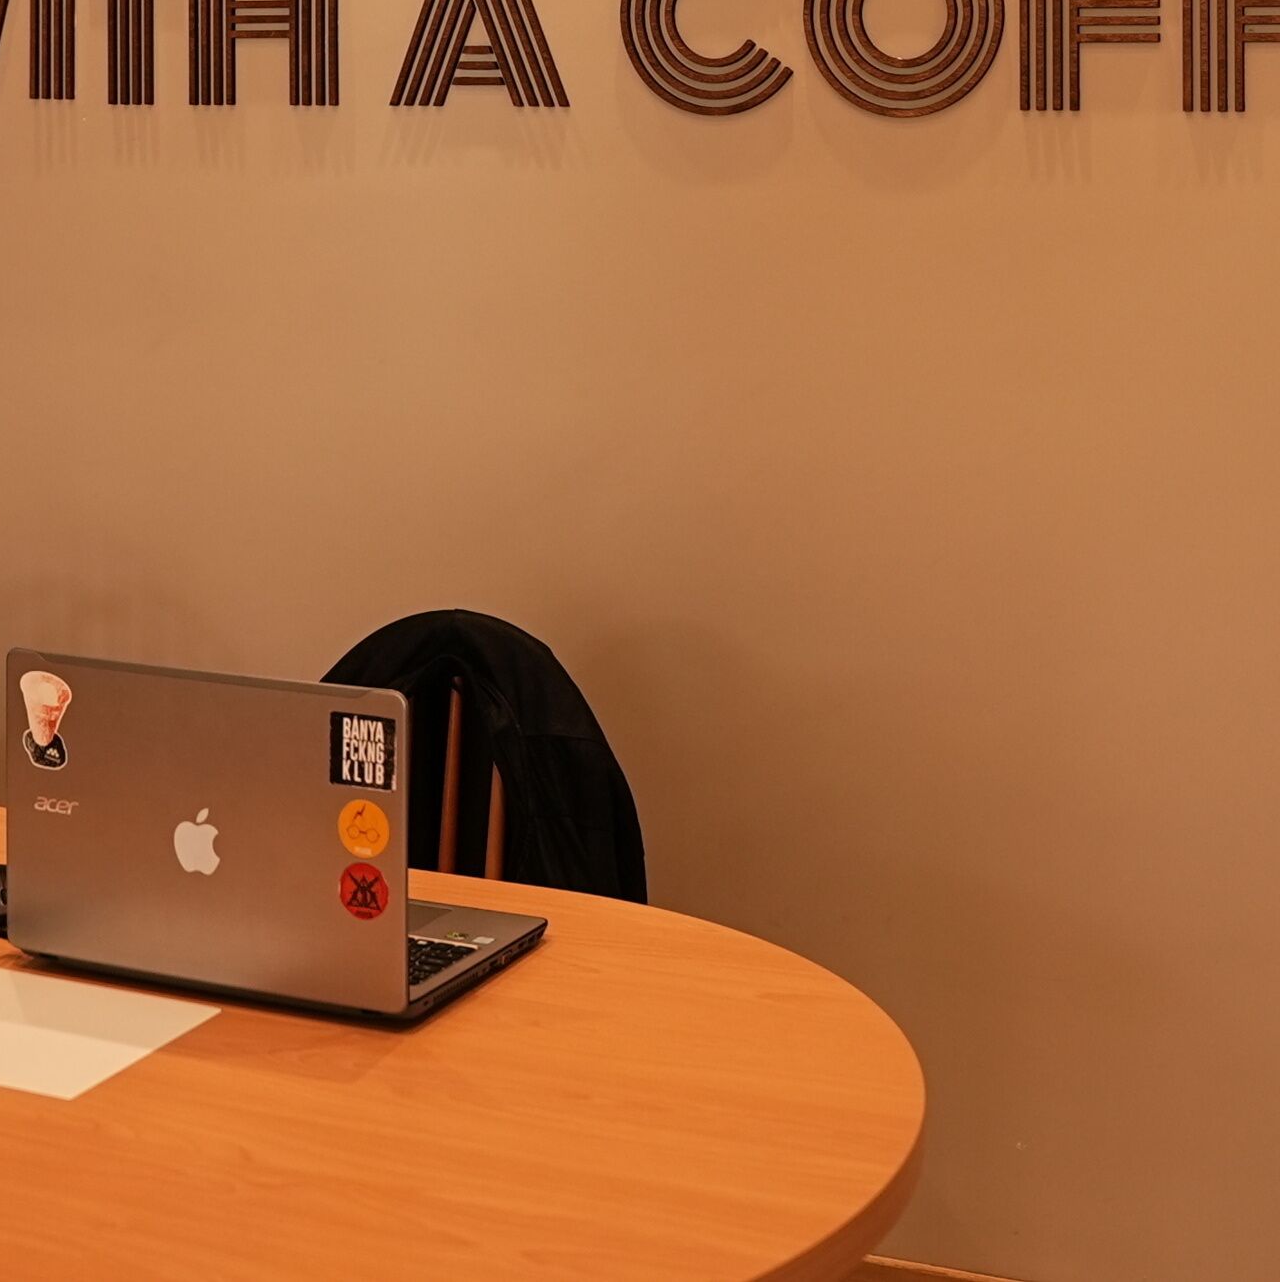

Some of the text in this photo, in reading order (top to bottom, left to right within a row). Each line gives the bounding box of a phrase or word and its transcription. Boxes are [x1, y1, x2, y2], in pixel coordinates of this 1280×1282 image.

[342, 738, 384, 765] FCKNG
[342, 759, 384, 786] KLUB
[34, 796, 79, 815] acer
